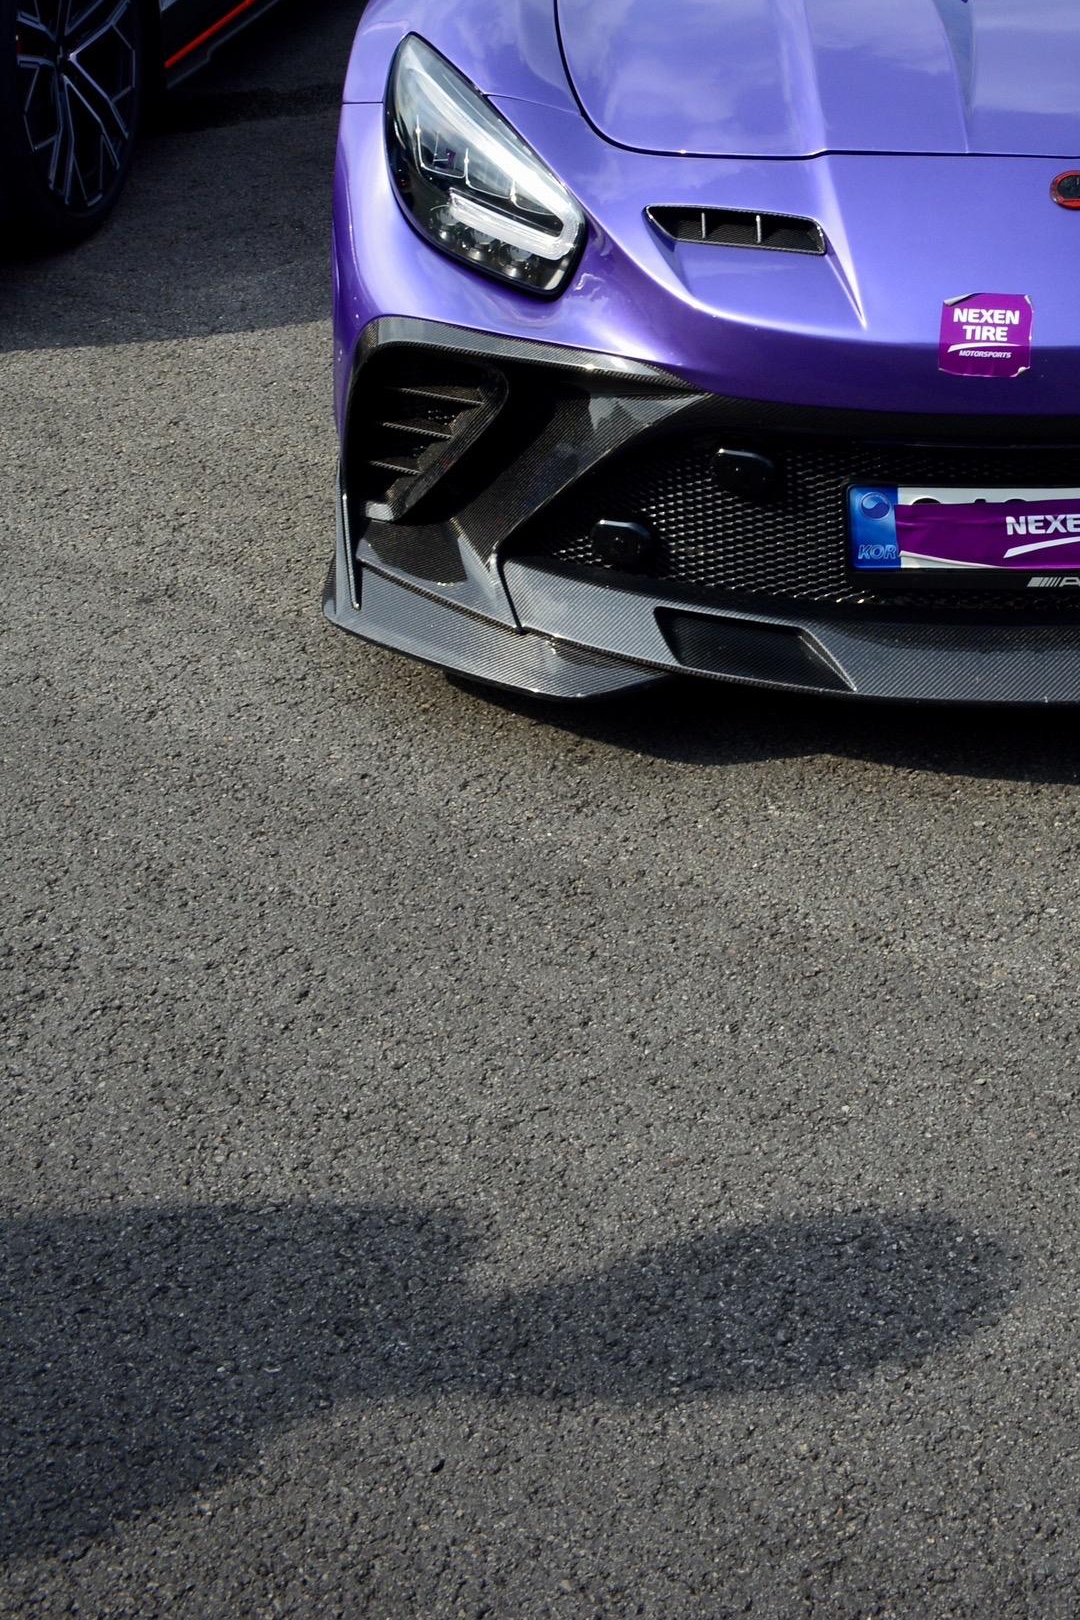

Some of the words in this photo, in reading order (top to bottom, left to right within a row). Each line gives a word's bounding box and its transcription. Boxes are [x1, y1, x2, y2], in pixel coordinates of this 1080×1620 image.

[953, 307, 1020, 325] NEXEN
[962, 325, 1009, 342] TIRE
[959, 349, 1012, 359] MOTORSPORTS
[857, 544, 897, 560] KOR
